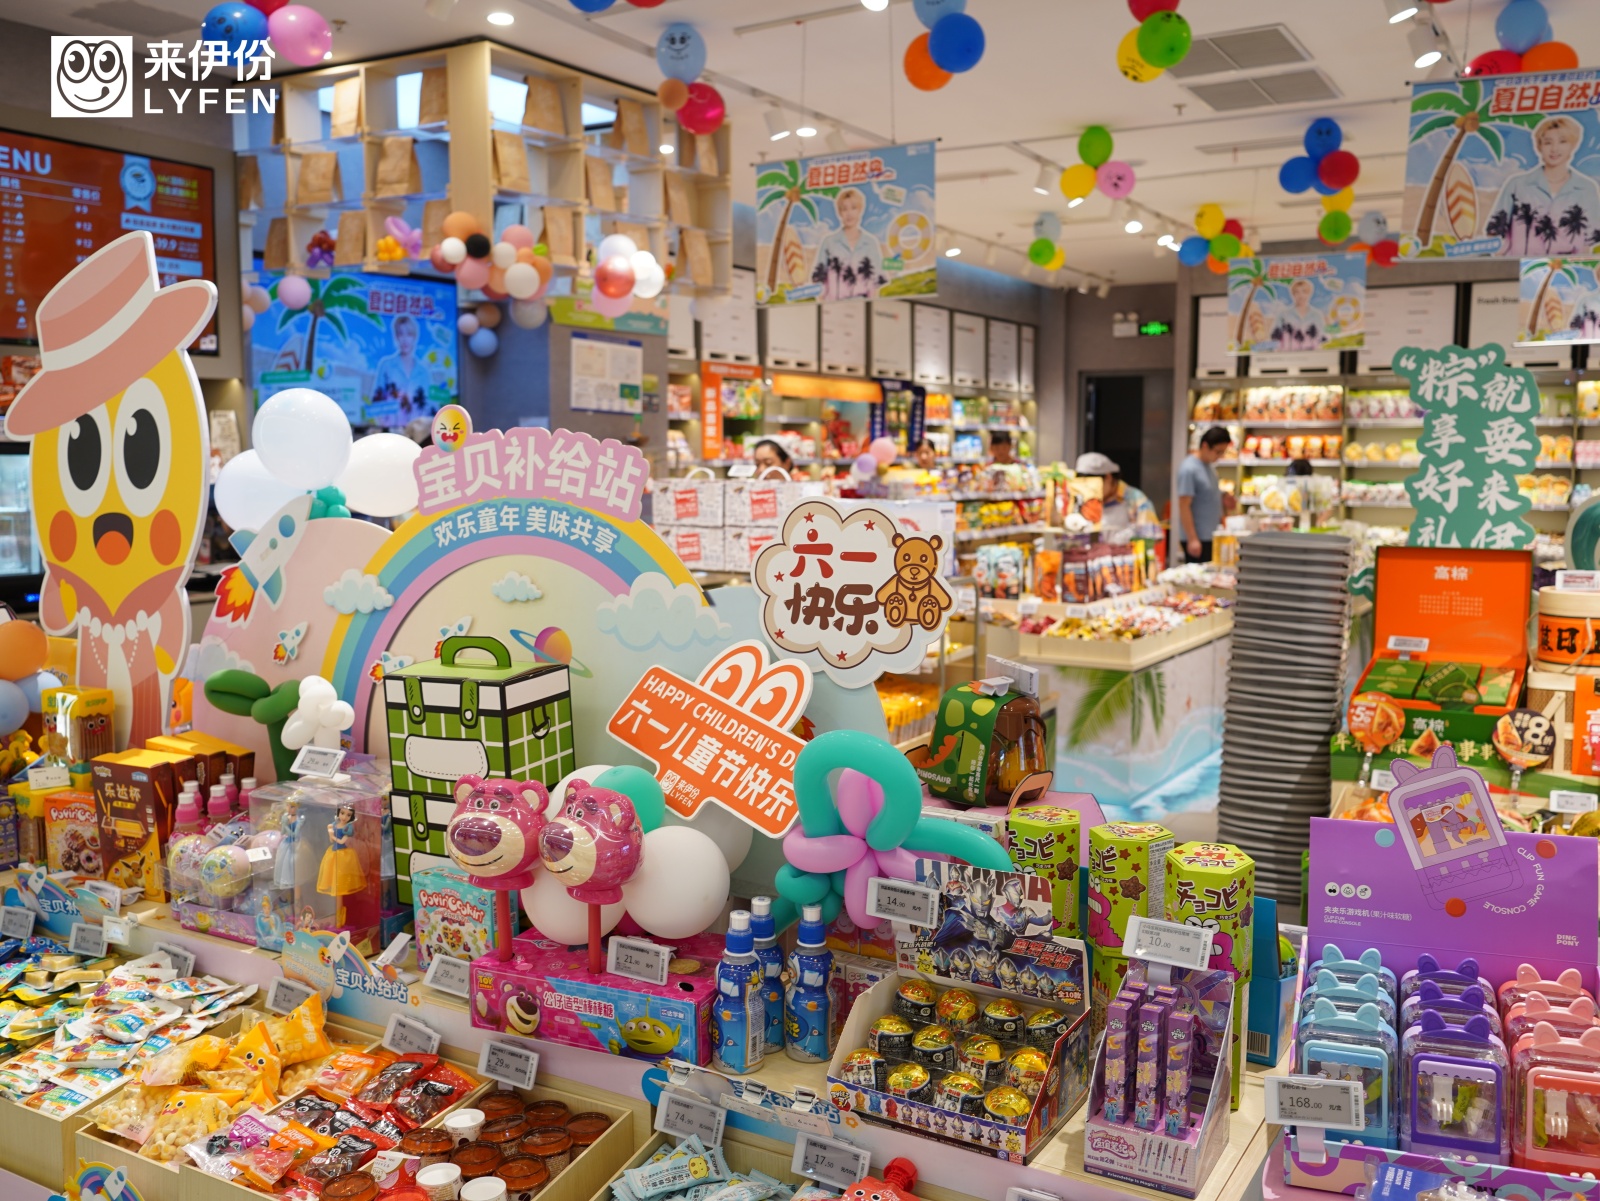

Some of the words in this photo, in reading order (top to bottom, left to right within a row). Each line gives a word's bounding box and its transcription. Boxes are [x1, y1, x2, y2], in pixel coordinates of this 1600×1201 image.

[418, 436, 642, 514] 宝贝补给站
[433, 504, 521, 548] 欢乐童年
[525, 505, 618, 555] 美味共享
[789, 528, 878, 579] 六一
[784, 582, 880, 636] 快乐
[643, 674, 696, 711] HAPPY
[692, 702, 783, 760] CHILDREN'S
[617, 698, 795, 823] 六一儿童节快乐
[669, 788, 695, 809] LYFEN
[675, 778, 701, 800] 来伊份
[1517, 846, 1536, 862] CLIP
[1532, 862, 1546, 881] FUN
[1175, 875, 1239, 914] チョコビ
[1526, 883, 1545, 908] GAME
[1482, 900, 1527, 915] CONSOLE
[1556, 934, 1578, 942] DING
[336, 967, 408, 1004] 宝贝补给站
[478, 976, 494, 984] TOY
[542, 990, 615, 1019] 公仔造型棒棒糖
[1288, 1096, 1323, 1109] 168.00
[815, 1154, 834, 1168] 17.50
